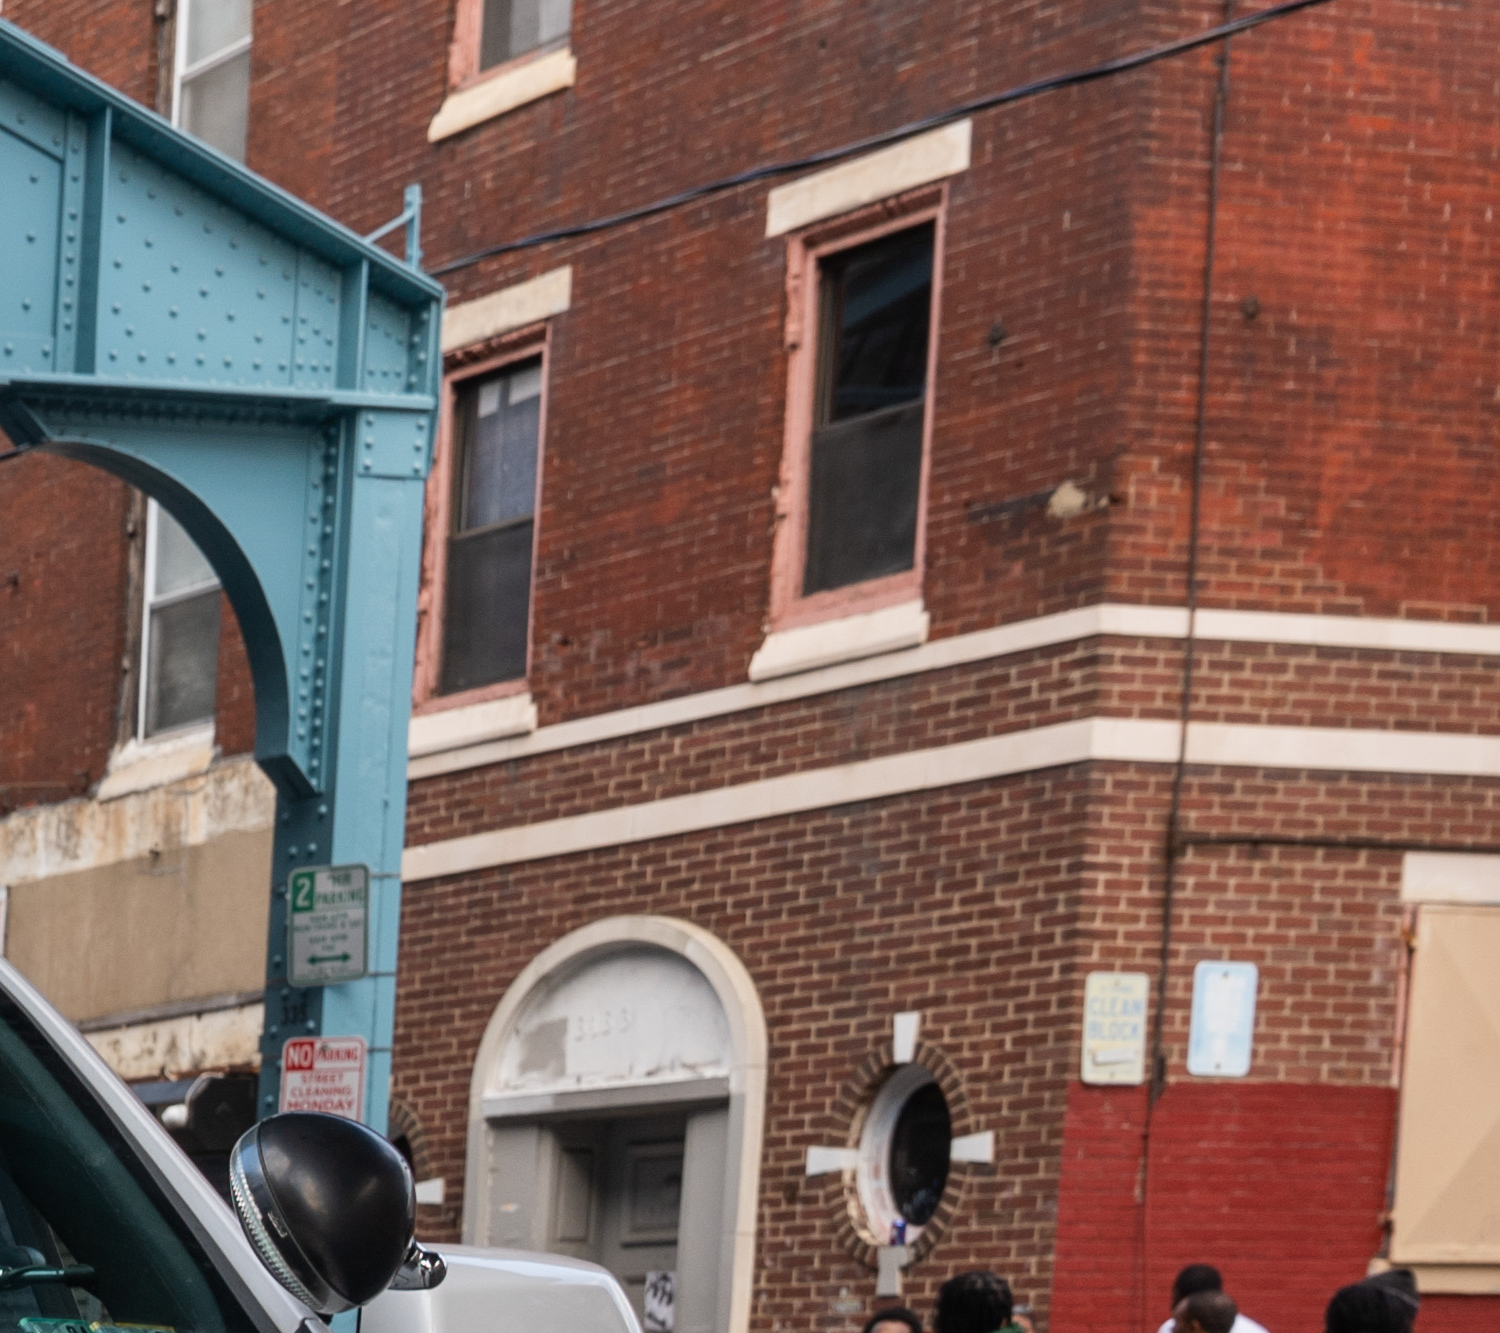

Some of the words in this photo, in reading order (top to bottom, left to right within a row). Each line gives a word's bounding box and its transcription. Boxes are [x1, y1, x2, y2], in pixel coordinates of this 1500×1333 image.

[295, 876, 313, 911] 2
[286, 1044, 313, 1068] NO
[301, 1073, 345, 1085] STREET
[290, 1087, 354, 1099] CLEANING
